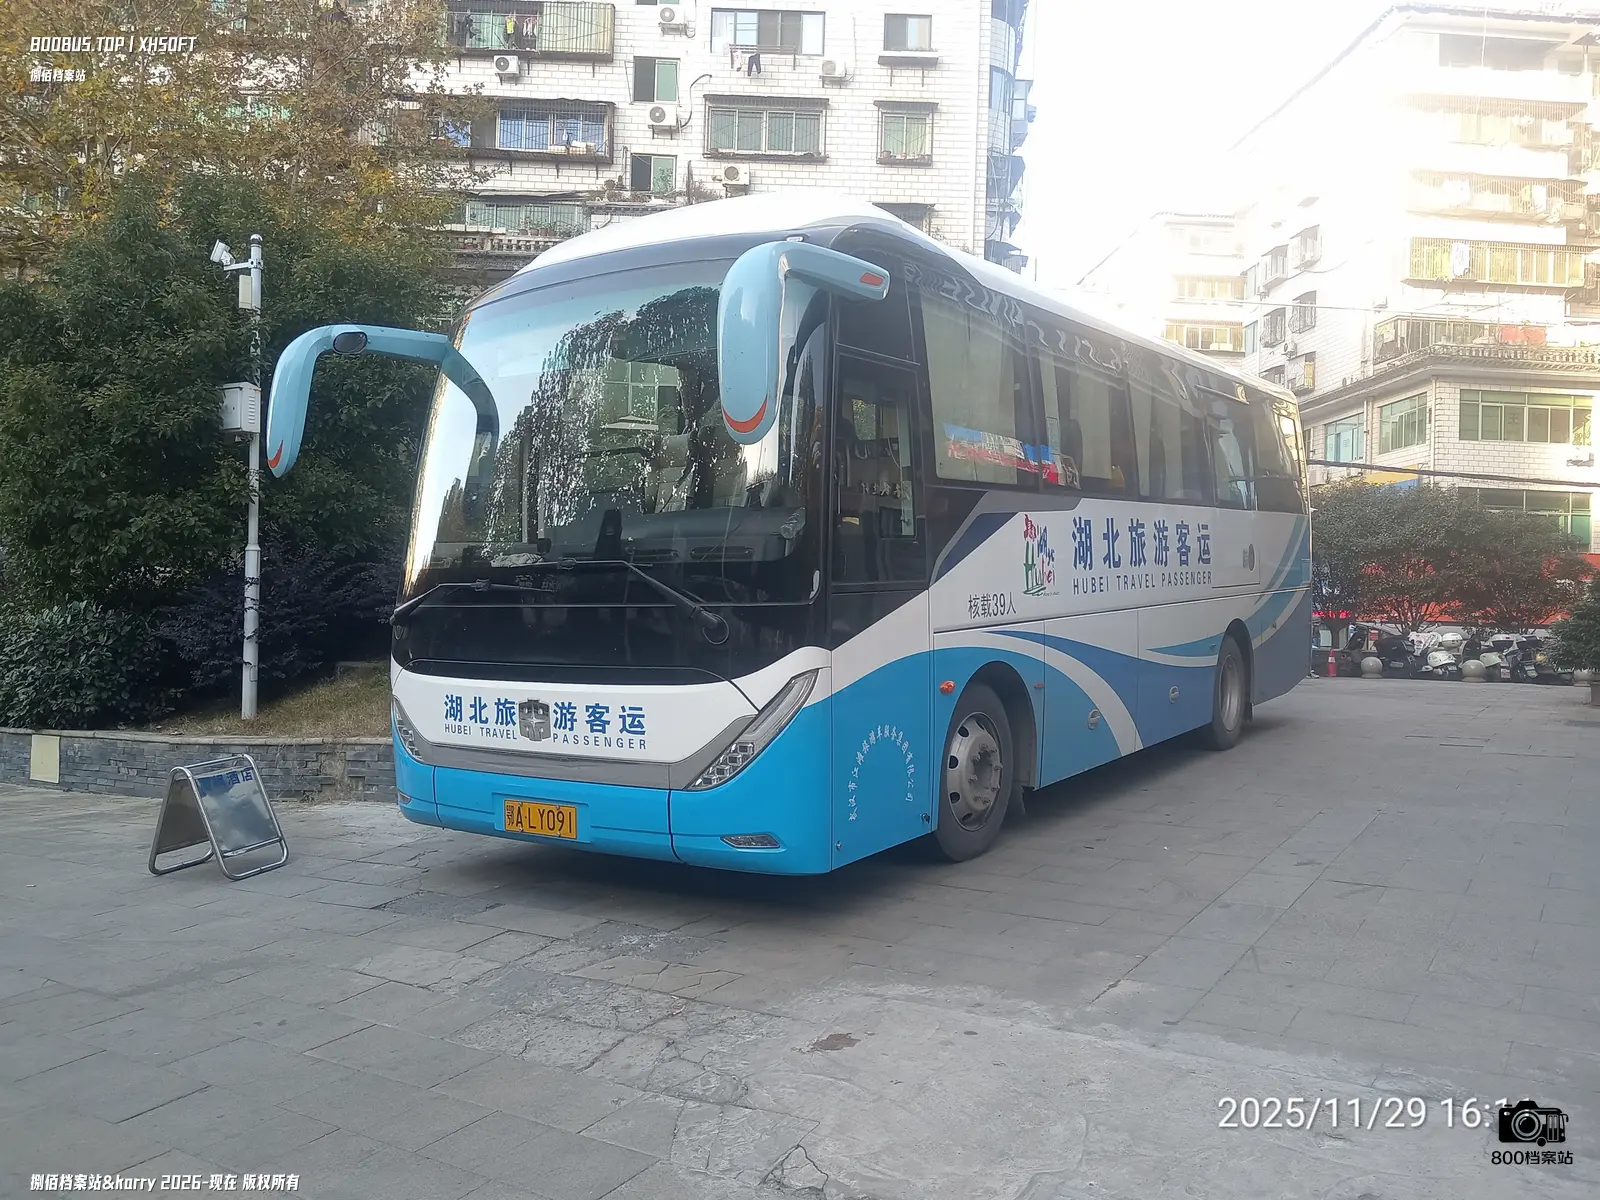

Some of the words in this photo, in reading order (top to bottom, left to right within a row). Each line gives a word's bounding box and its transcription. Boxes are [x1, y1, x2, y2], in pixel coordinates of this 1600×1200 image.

[1071, 516, 1212, 571] 湖北旅游客运
[1072, 577, 1110, 596] HUBEI
[1116, 574, 1156, 592] TRAVEL
[1161, 571, 1212, 589] PASSENGER
[967, 592, 1018, 620] 核载39人
[444, 723, 472, 737] HUBEI
[479, 726, 518, 741] TRAVEL
[552, 733, 647, 750] PASSENGER
